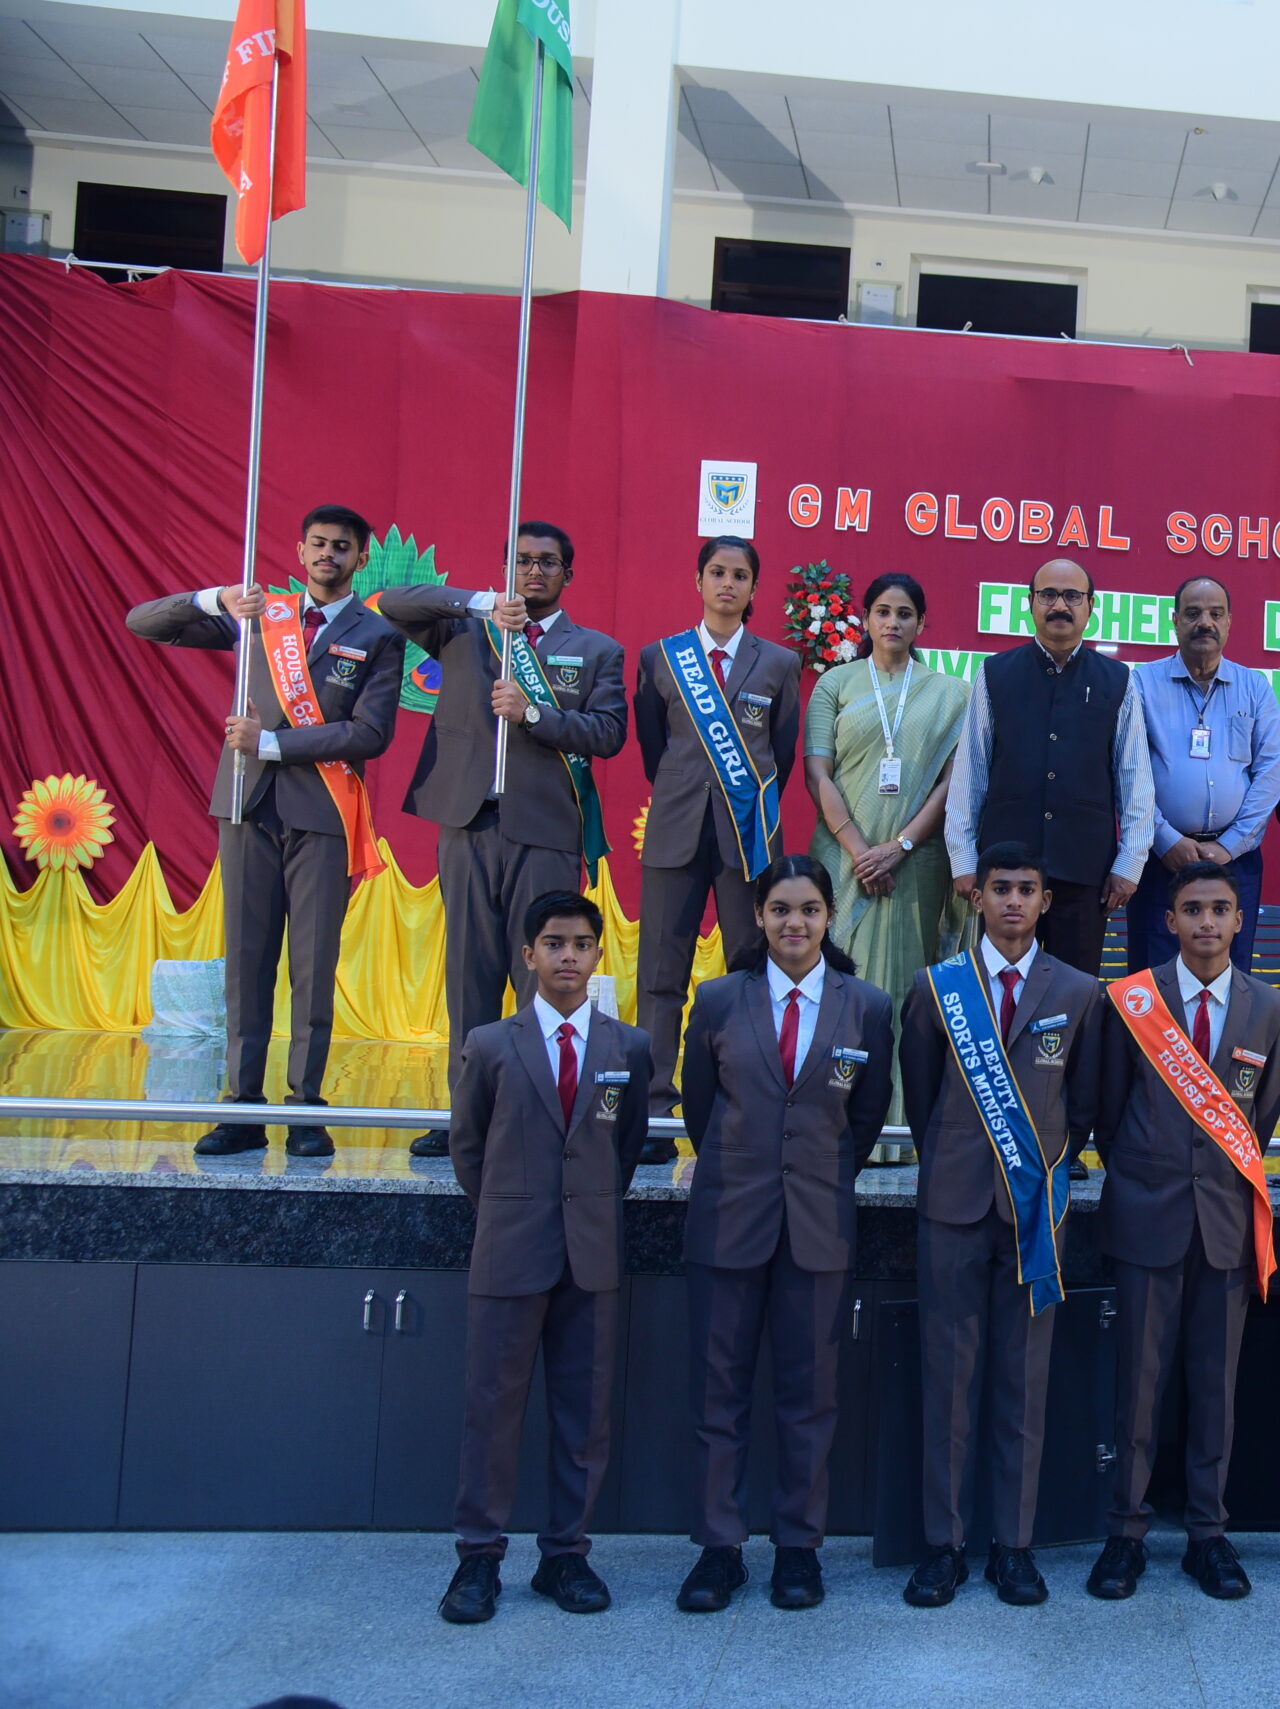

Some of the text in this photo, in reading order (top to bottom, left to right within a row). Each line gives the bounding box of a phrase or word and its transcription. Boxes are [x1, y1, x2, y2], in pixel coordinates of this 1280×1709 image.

[904, 492, 1130, 552] GLOBAL
[282, 634, 307, 696] HOUSE
[675, 646, 749, 786] HEAD GIRL
[943, 991, 1022, 1171] SPORTS MINISTER
[979, 1037, 1018, 1110] DEPUTY
[1162, 1027, 1222, 1097] DEPUTY
[1158, 1050, 1206, 1108] HOUSE
[1203, 1109, 1226, 1130] OF
[1224, 1131, 1252, 1168] FIRE
